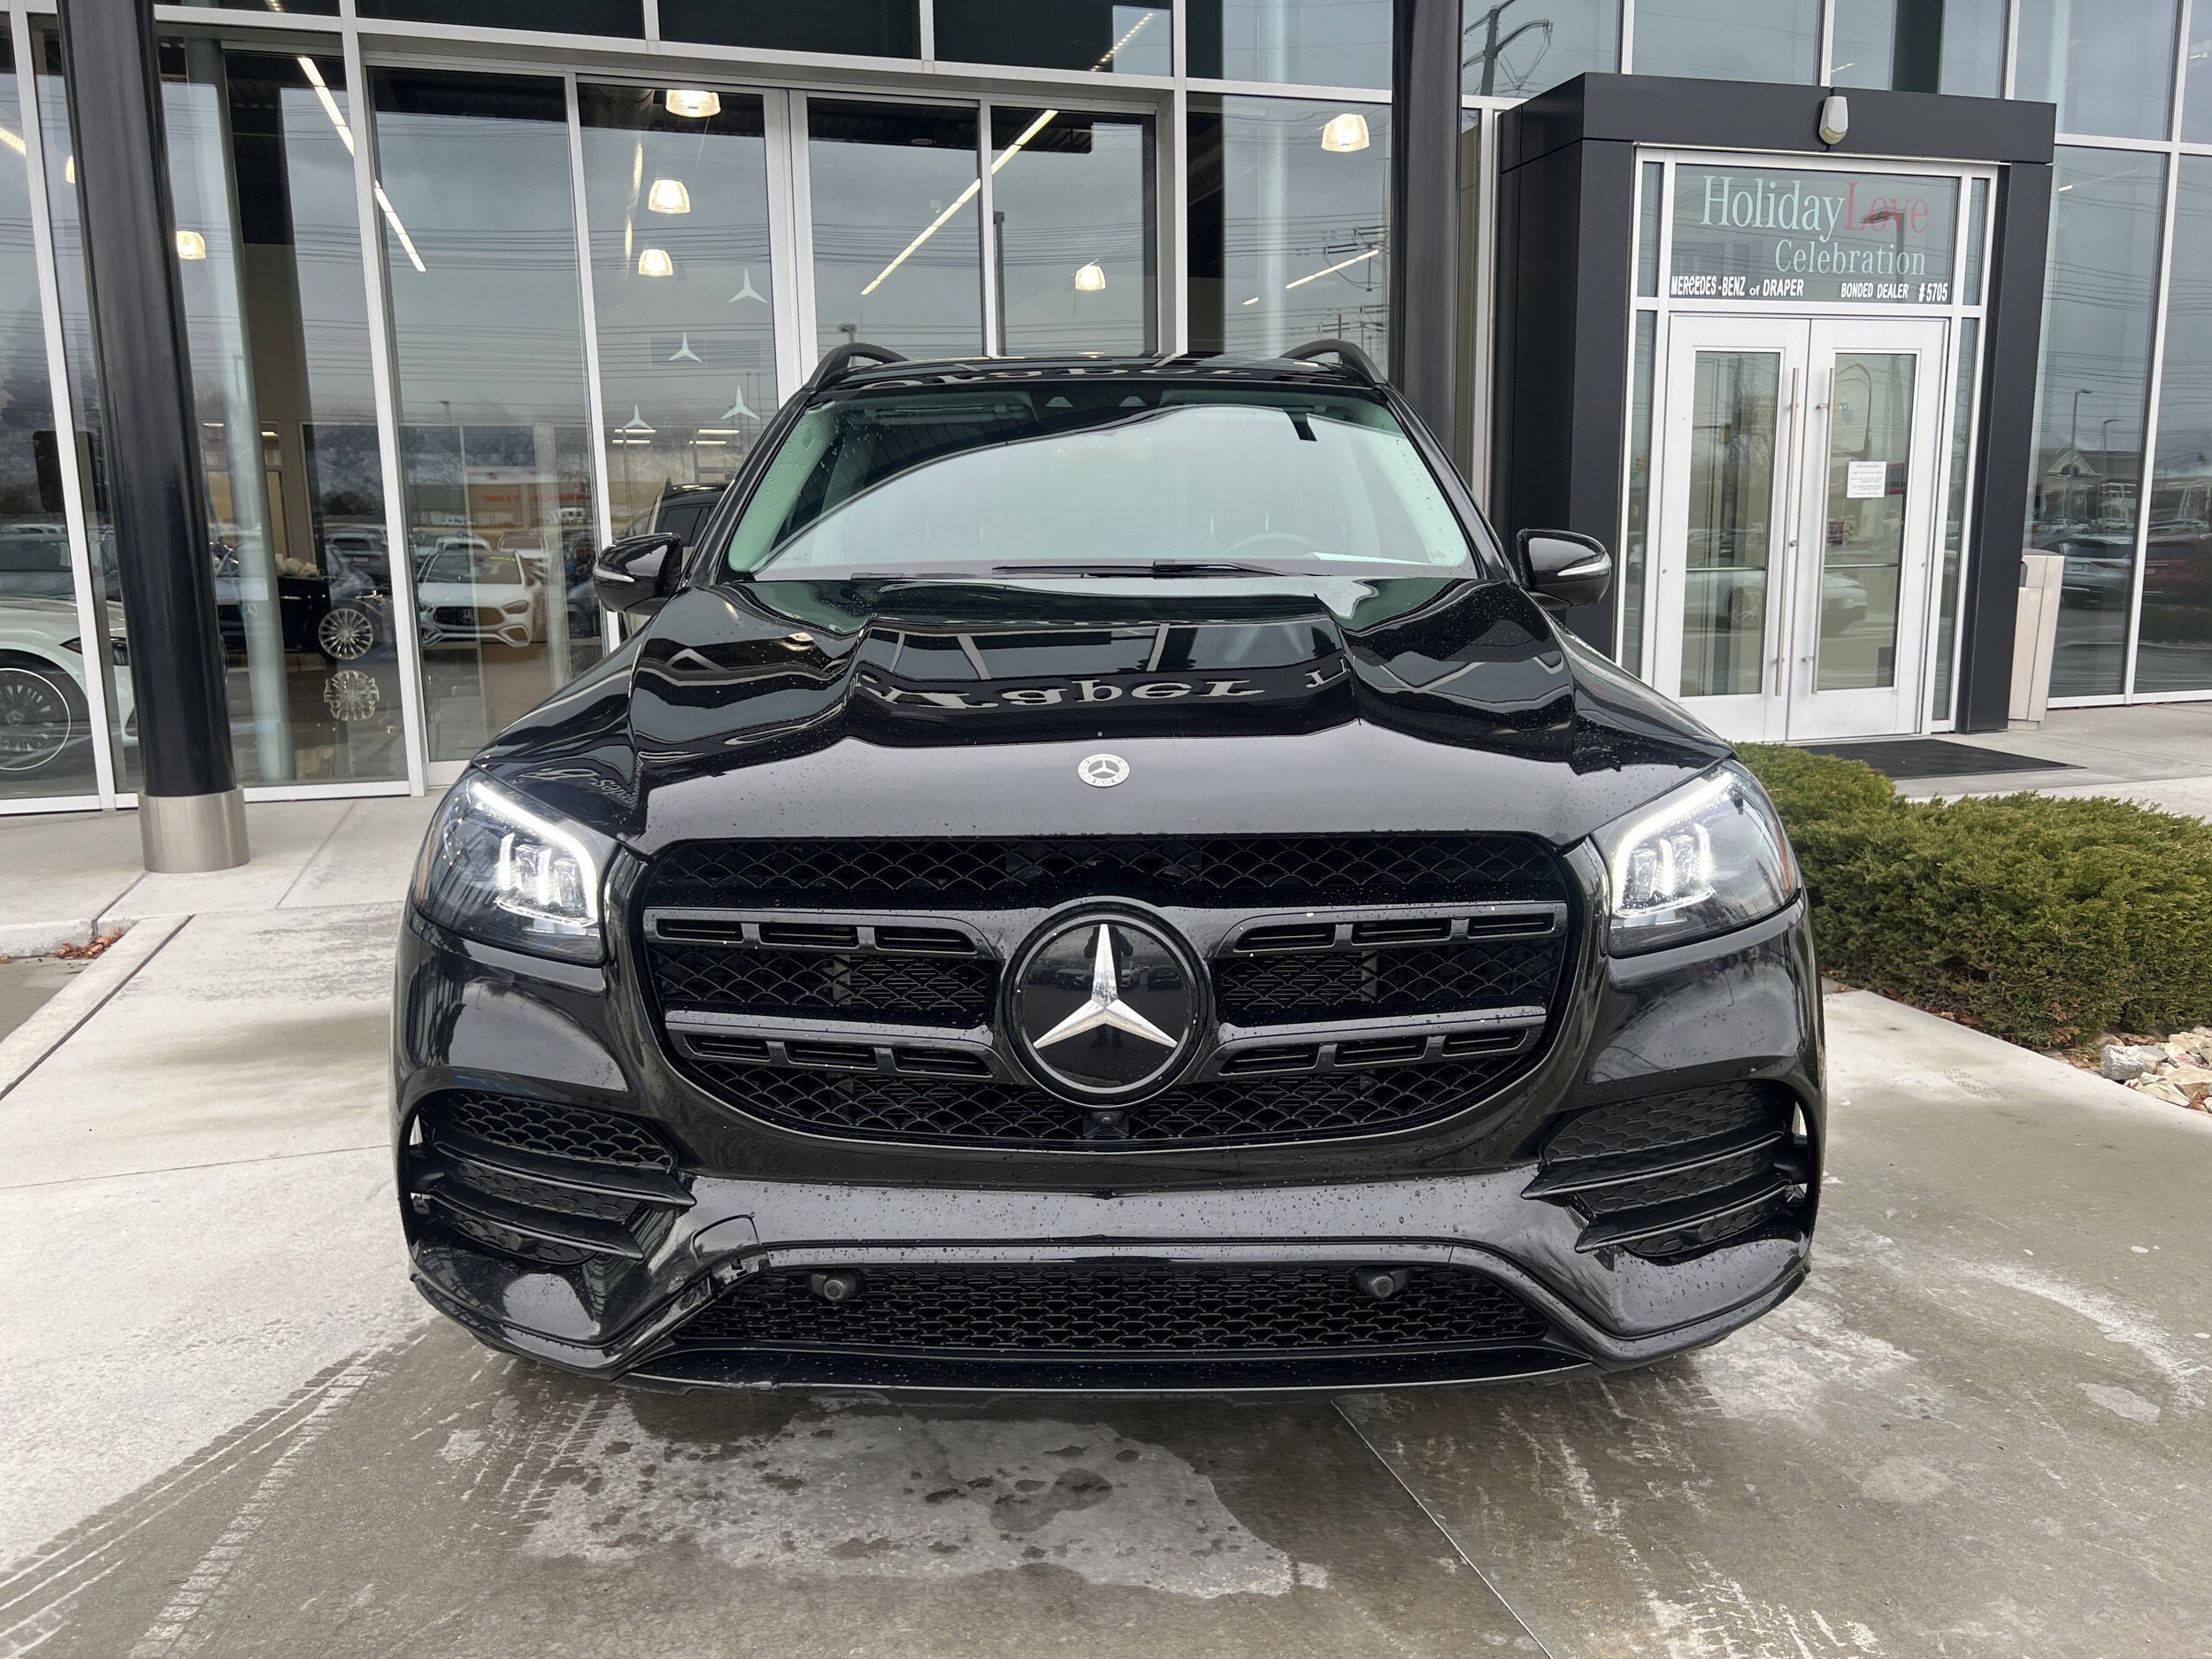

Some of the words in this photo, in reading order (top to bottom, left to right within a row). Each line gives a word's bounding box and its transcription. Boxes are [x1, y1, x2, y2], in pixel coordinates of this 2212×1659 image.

[1775, 239, 1926, 275] Celebration
[1749, 285, 1761, 296] of
[1763, 279, 1804, 296] DRAPER
[1840, 282, 1874, 298] BONDED
[1876, 283, 1909, 299] DEALER
